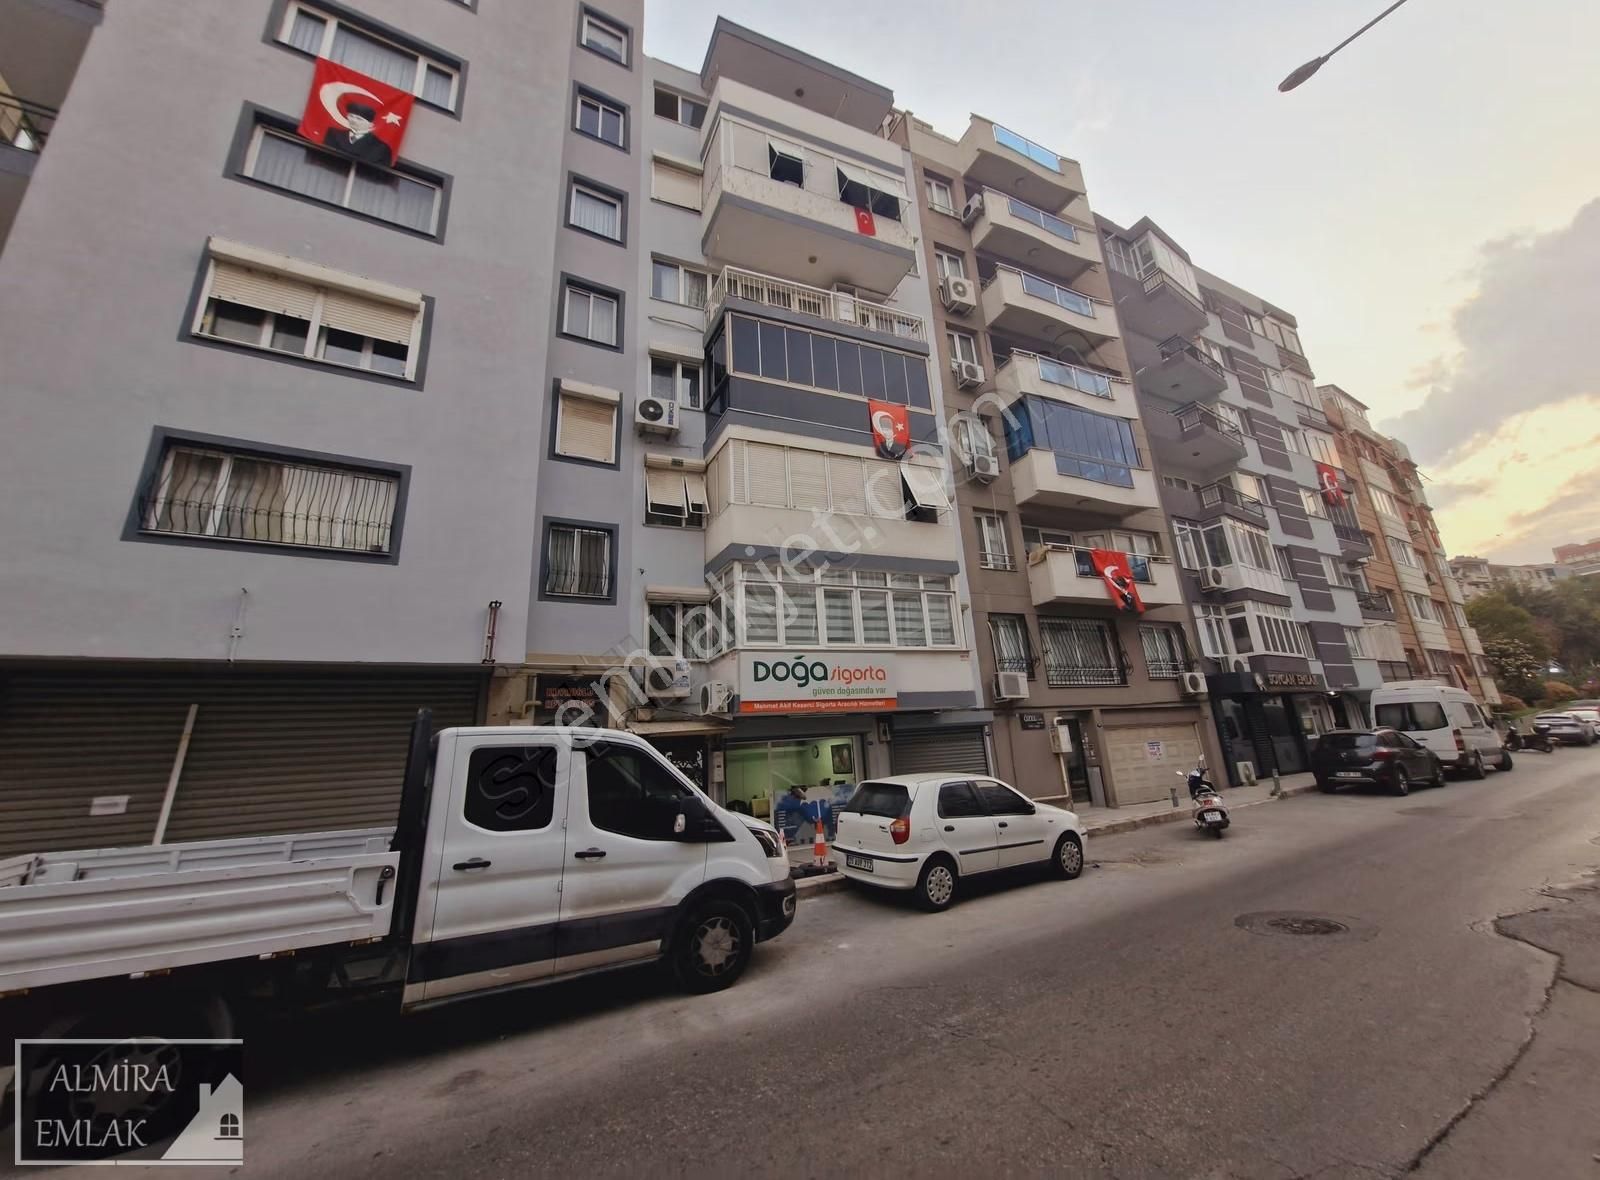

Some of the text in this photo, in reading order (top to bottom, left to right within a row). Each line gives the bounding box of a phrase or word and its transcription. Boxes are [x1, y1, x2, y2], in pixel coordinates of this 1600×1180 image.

[812, 688, 836, 697] güven
[837, 686, 874, 697] doğasında
[815, 701, 837, 709] Sigorta
